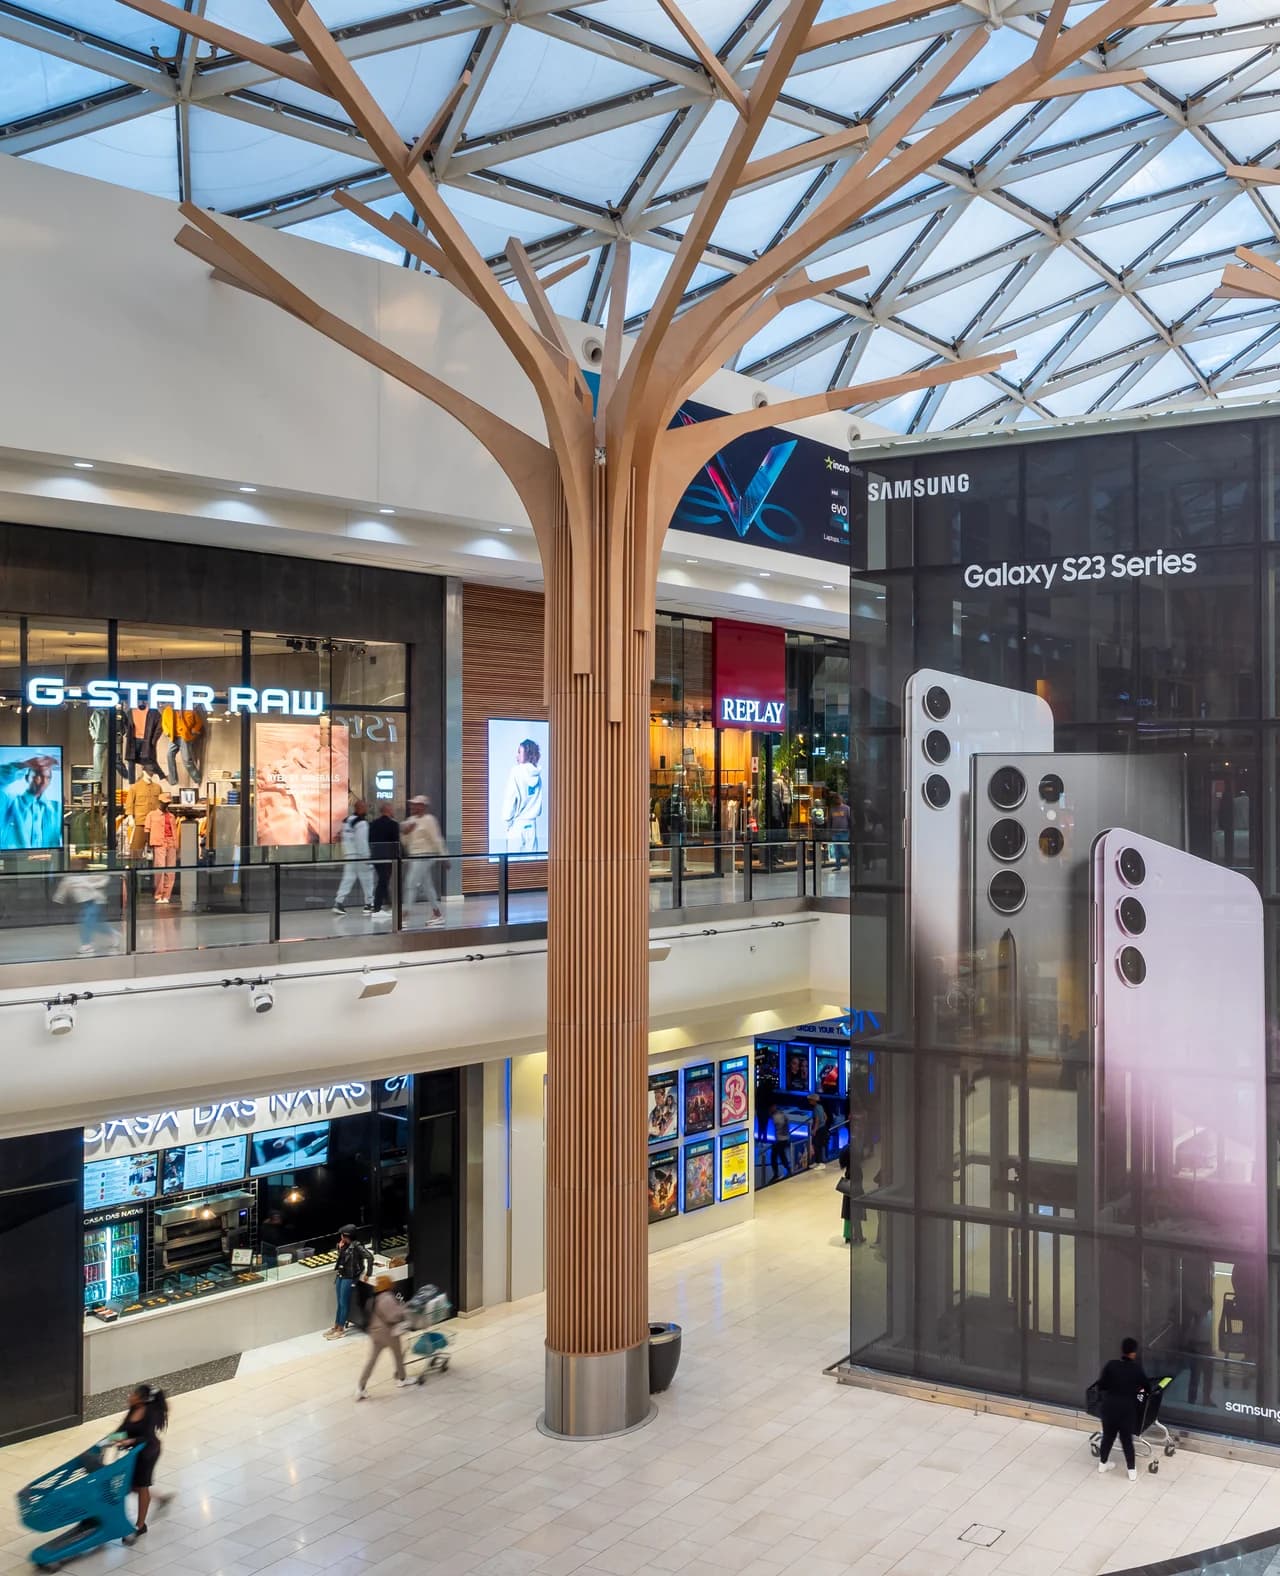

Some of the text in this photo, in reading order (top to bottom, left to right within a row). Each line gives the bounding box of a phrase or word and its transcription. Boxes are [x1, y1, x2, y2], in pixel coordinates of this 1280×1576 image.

[867, 473, 970, 501] SAMSUNG
[831, 503, 848, 516] evo
[964, 549, 1197, 589] Galaxy S23 Series
[28, 677, 325, 717] G-STAR RAW
[722, 698, 785, 724] REPLAY
[376, 791, 393, 799] RAW
[819, 1026, 835, 1034] YOUR
[83, 1207, 144, 1225] CASA DAS NATAS
